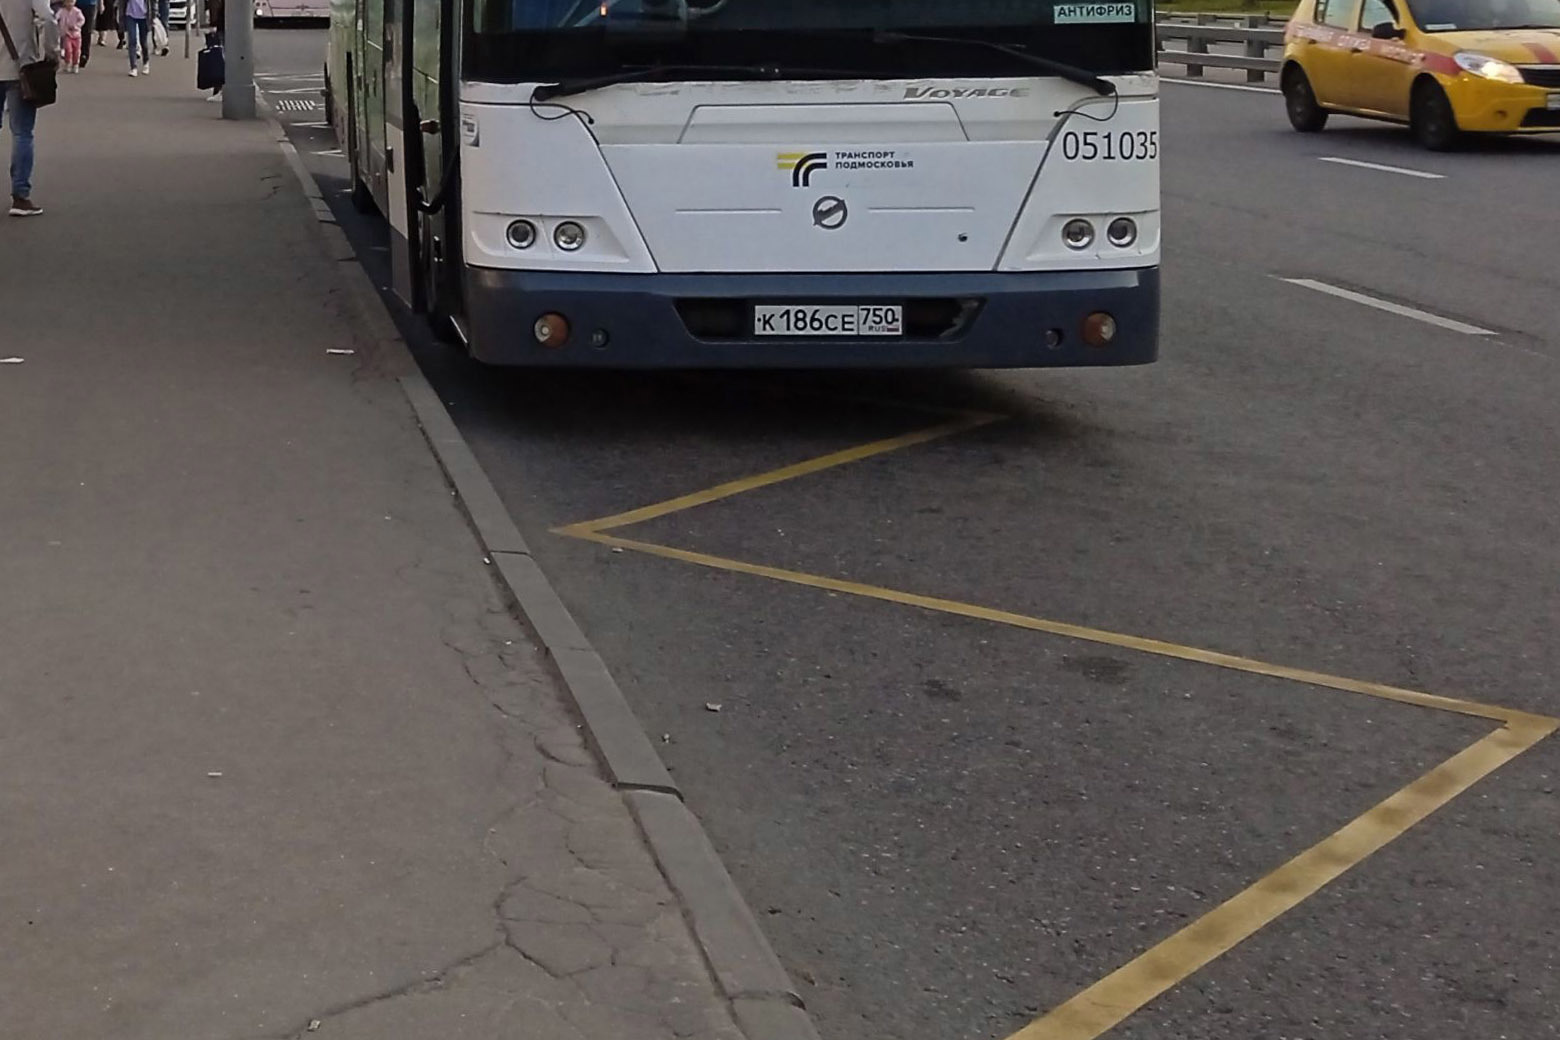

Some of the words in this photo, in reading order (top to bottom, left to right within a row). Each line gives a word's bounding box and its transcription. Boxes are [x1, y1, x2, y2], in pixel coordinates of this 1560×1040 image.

[1056, 4, 1134, 19] АНТИФРИЗ
[1062, 130, 1158, 161] 051035
[834, 150, 896, 160] ТРАНСПОРТ
[834, 160, 914, 170] ПОДМОСКОВЬЯ
[860, 307, 897, 326] 750
